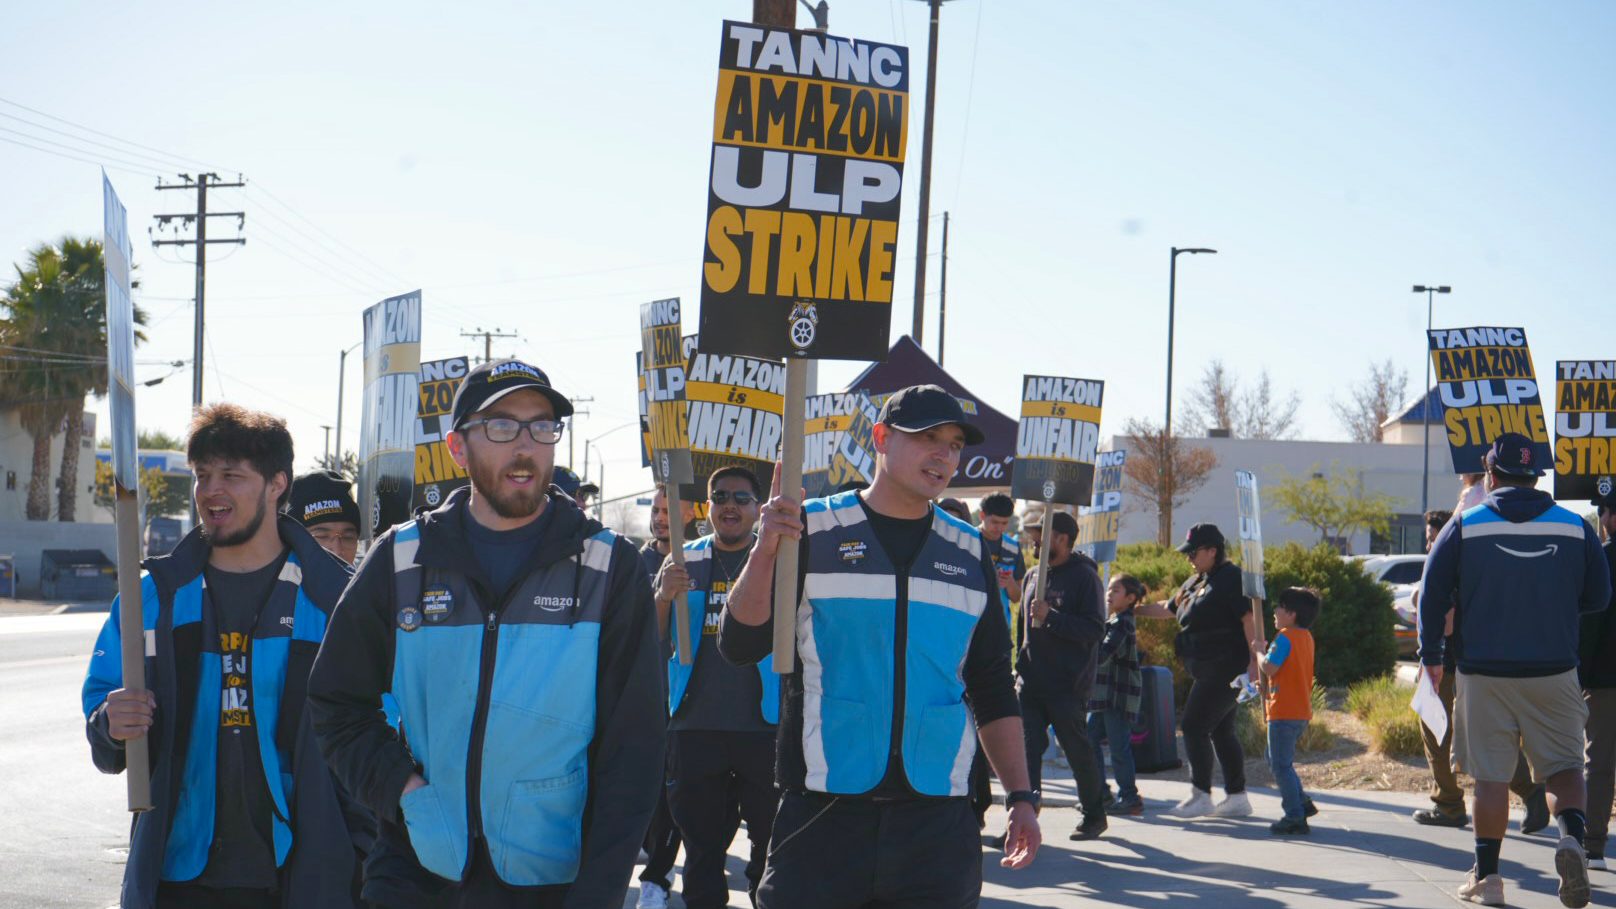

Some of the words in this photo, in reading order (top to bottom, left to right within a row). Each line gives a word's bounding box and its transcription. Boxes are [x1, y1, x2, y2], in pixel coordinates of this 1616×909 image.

[730, 25, 903, 88] TANNC
[722, 74, 904, 158] AMAZON
[711, 145, 901, 215] ULP
[704, 205, 898, 303] STRIKE
[1431, 328, 1524, 349] TANNC
[689, 353, 785, 396] AMAZON
[1439, 348, 1532, 379] AMAZON
[1560, 362, 1616, 380] TAN
[645, 367, 686, 401] ULP
[728, 386, 747, 404] is
[1024, 377, 1100, 407] AMAZON
[1439, 379, 1538, 408] ULP
[805, 393, 859, 420] MAZO
[1051, 402, 1066, 416] is
[686, 401, 781, 463] UNFAIR
[824, 415, 838, 430] is
[1445, 405, 1548, 447] STRIKE
[1017, 416, 1099, 464] UNFAIR
[304, 500, 341, 514] AMAZON
[934, 561, 967, 575] amazon
